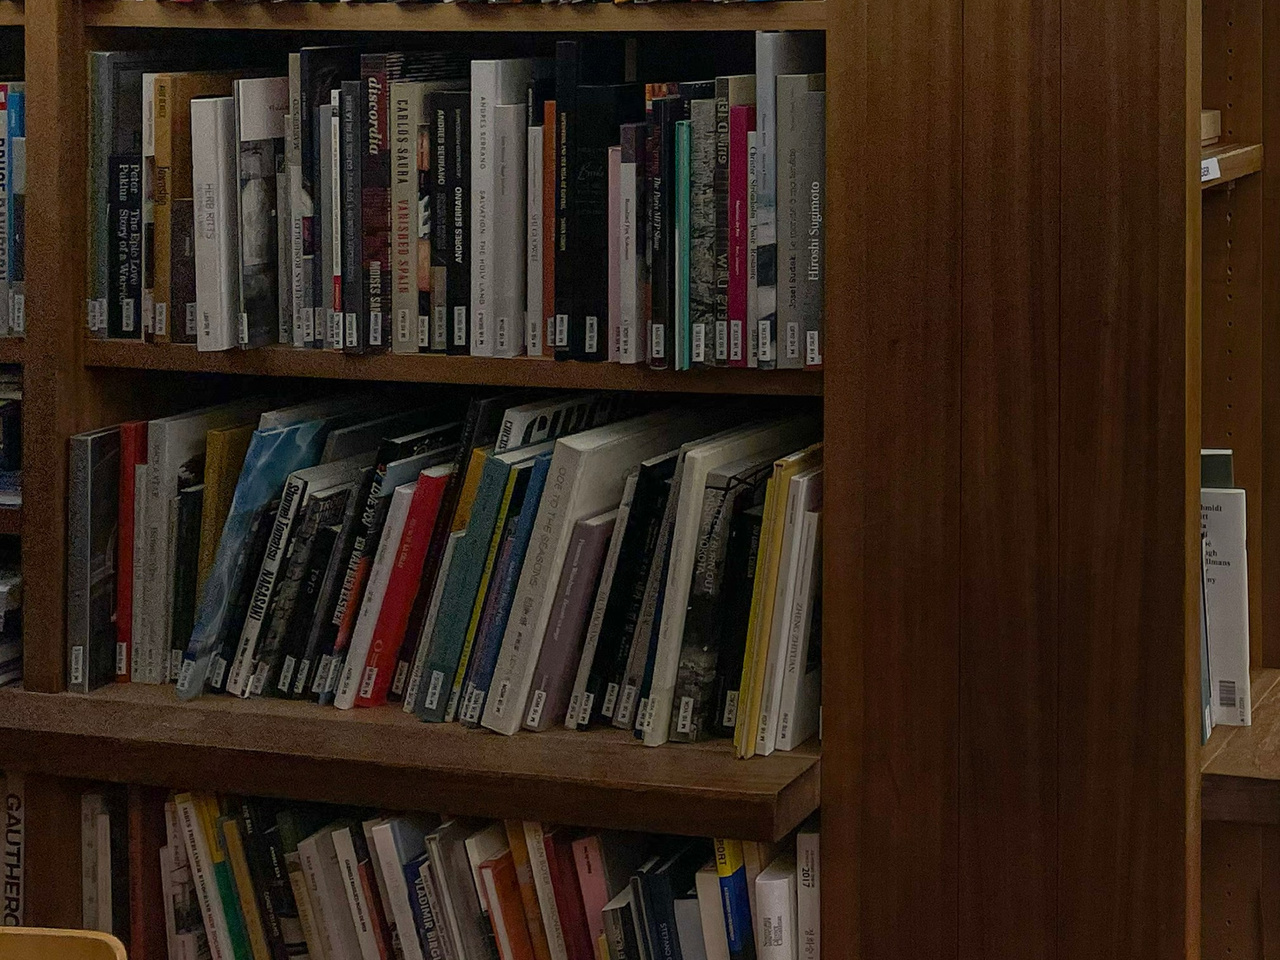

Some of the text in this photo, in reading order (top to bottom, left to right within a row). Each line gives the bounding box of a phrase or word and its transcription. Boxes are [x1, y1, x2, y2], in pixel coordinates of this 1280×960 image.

[368, 76, 382, 155] discordia
[396, 99, 409, 184] CARLOS SAURA
[120, 164, 140, 202] Peter Puklus
[118, 209, 129, 238] Story
[454, 187, 463, 227] SERRANO
[120, 240, 129, 251] of
[128, 208, 140, 286] The Epic Love
[397, 198, 410, 293] VANISHED SPAIN
[454, 228, 463, 264] ANDRES
[808, 182, 822, 281] Hiroshi Sugimoto
[498, 420, 513, 450] CIRCUS
[362, 482, 381, 527] LOVE YOU
[550, 494, 560, 508] TO
[543, 512, 556, 532] THE
[248, 482, 299, 622] Shomei Tomatsu NAGASAKI
[350, 550, 362, 568] VAN
[529, 534, 550, 586] SEASONS
[696, 534, 710, 574] YOKOTA
[702, 572, 714, 594] OUT
[788, 602, 803, 674] ZHENG ZHIYUAN
[182, 806, 192, 828] ARBUS
[533, 829, 550, 885] ADRIEN BOYER
[716, 840, 726, 866] PORT
[802, 866, 810, 888] 2017
[414, 878, 434, 929] VLADIMIR
